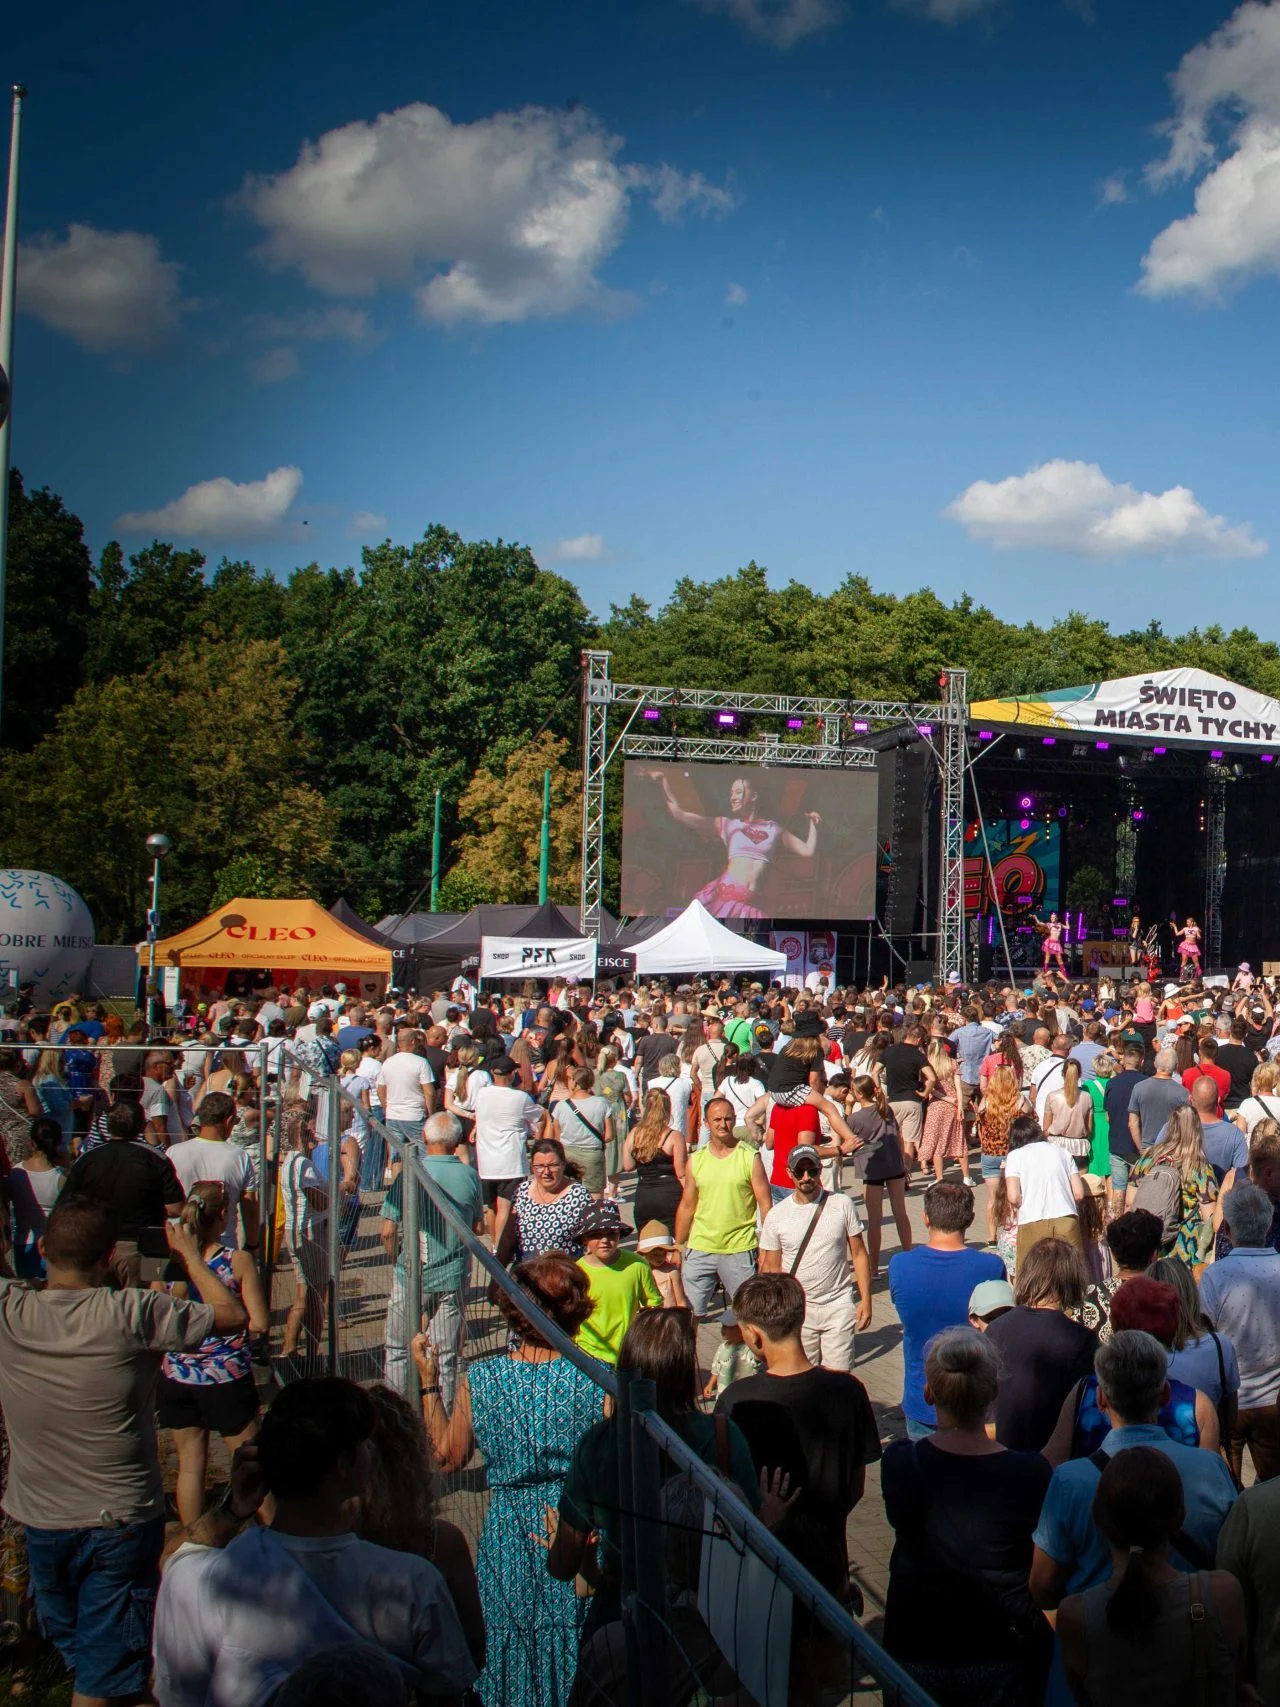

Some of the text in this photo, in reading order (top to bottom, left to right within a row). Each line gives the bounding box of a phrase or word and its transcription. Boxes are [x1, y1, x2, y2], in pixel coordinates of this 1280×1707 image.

[1139, 680, 1237, 713] ŚWIĘTO
[1094, 709, 1277, 741] MIASTA TYCHY
[226, 924, 316, 941] CLEO
[0, 934, 47, 948] OBRE
[208, 952, 236, 960] CLEO
[301, 954, 328, 962] CLEO
[569, 953, 586, 961] SHOP
